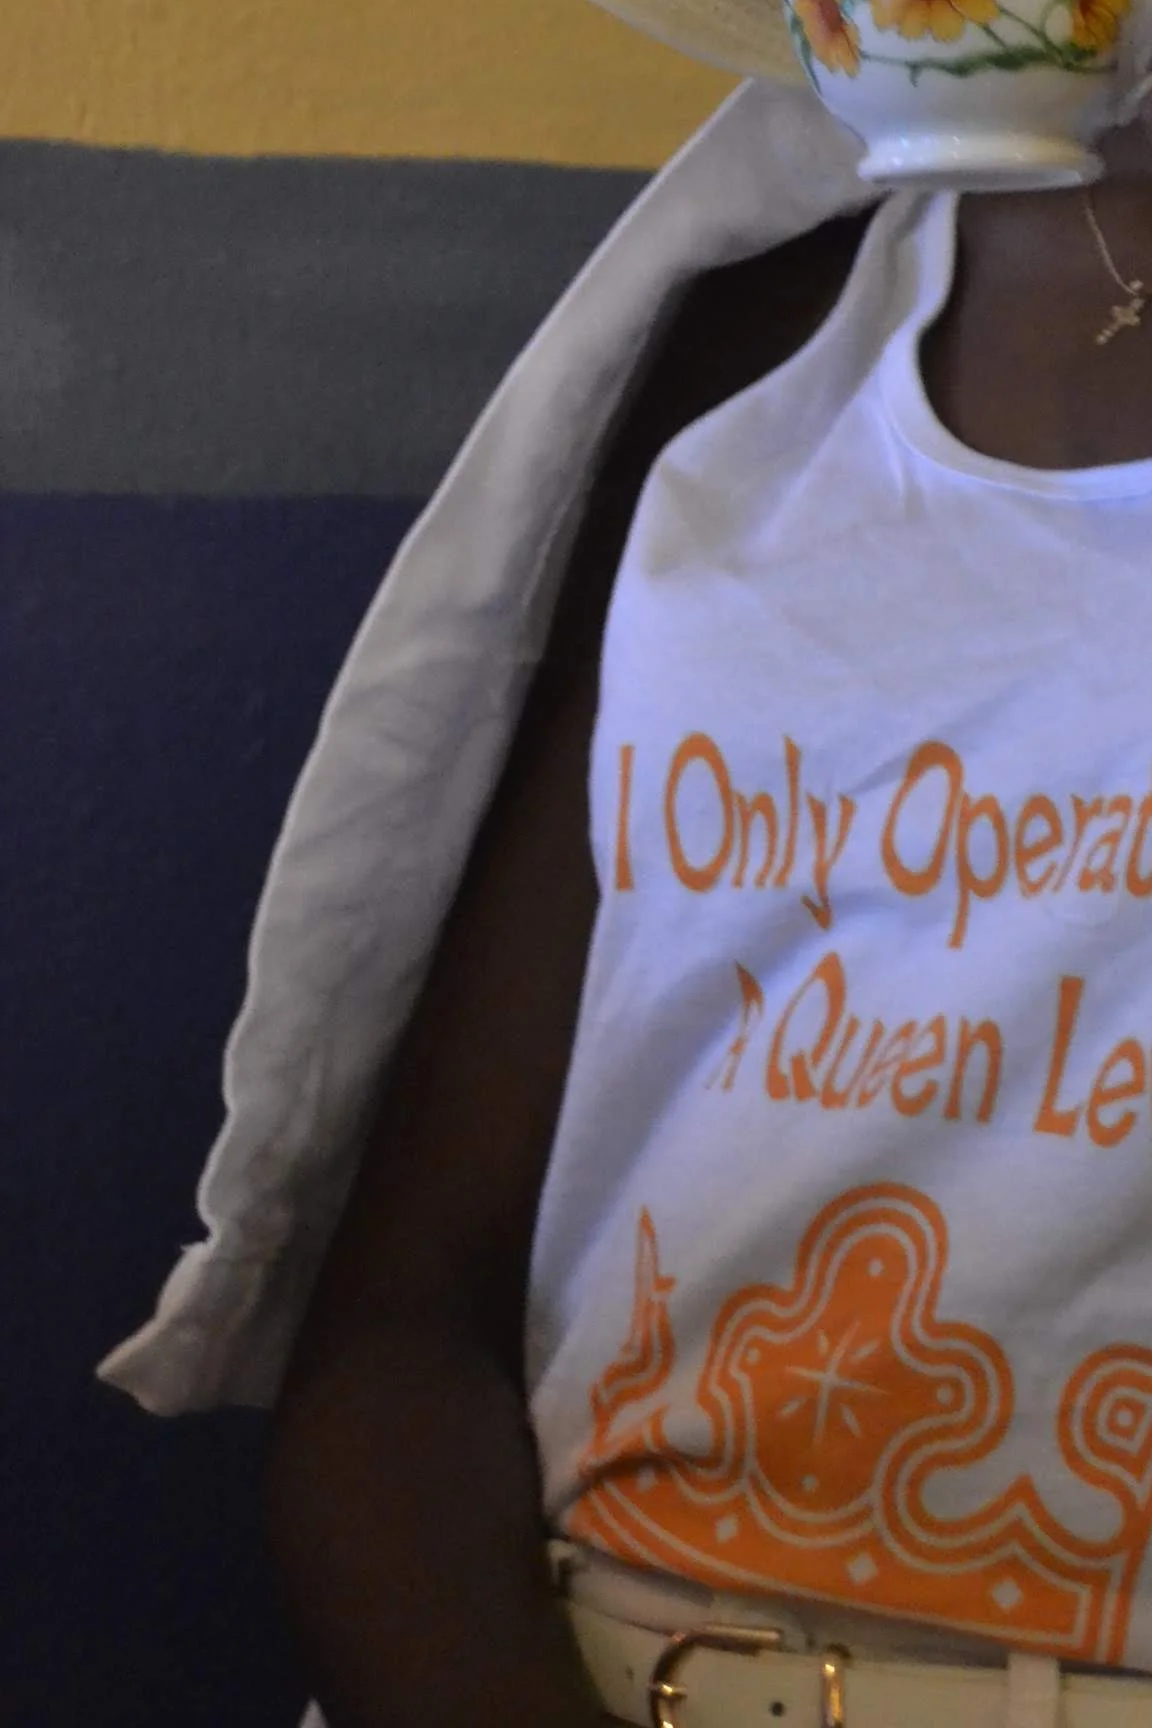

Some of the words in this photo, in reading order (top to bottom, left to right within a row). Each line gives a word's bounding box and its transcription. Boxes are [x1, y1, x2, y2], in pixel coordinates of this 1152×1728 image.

[615, 744, 635, 892] I
[665, 733, 857, 929] Only
[765, 952, 1003, 1125] Queen
